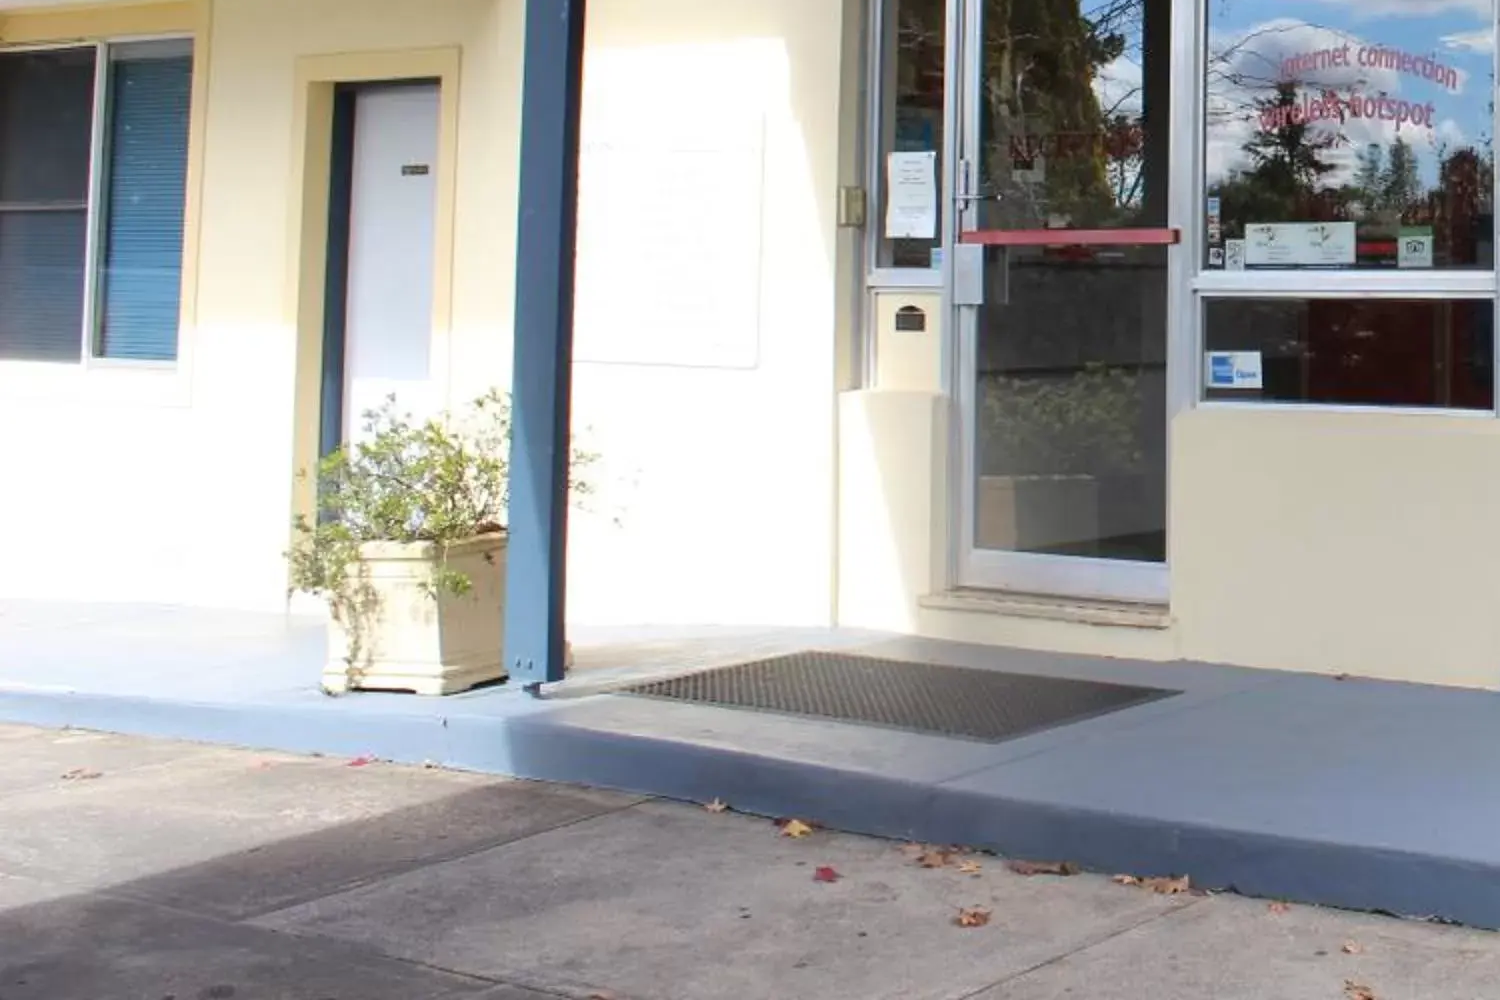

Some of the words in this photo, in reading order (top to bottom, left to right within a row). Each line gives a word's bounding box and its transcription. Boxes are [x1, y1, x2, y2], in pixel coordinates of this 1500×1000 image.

[1280, 43, 1350, 80] internet
[1357, 45, 1458, 91] connection
[1351, 88, 1435, 131] hotspot
